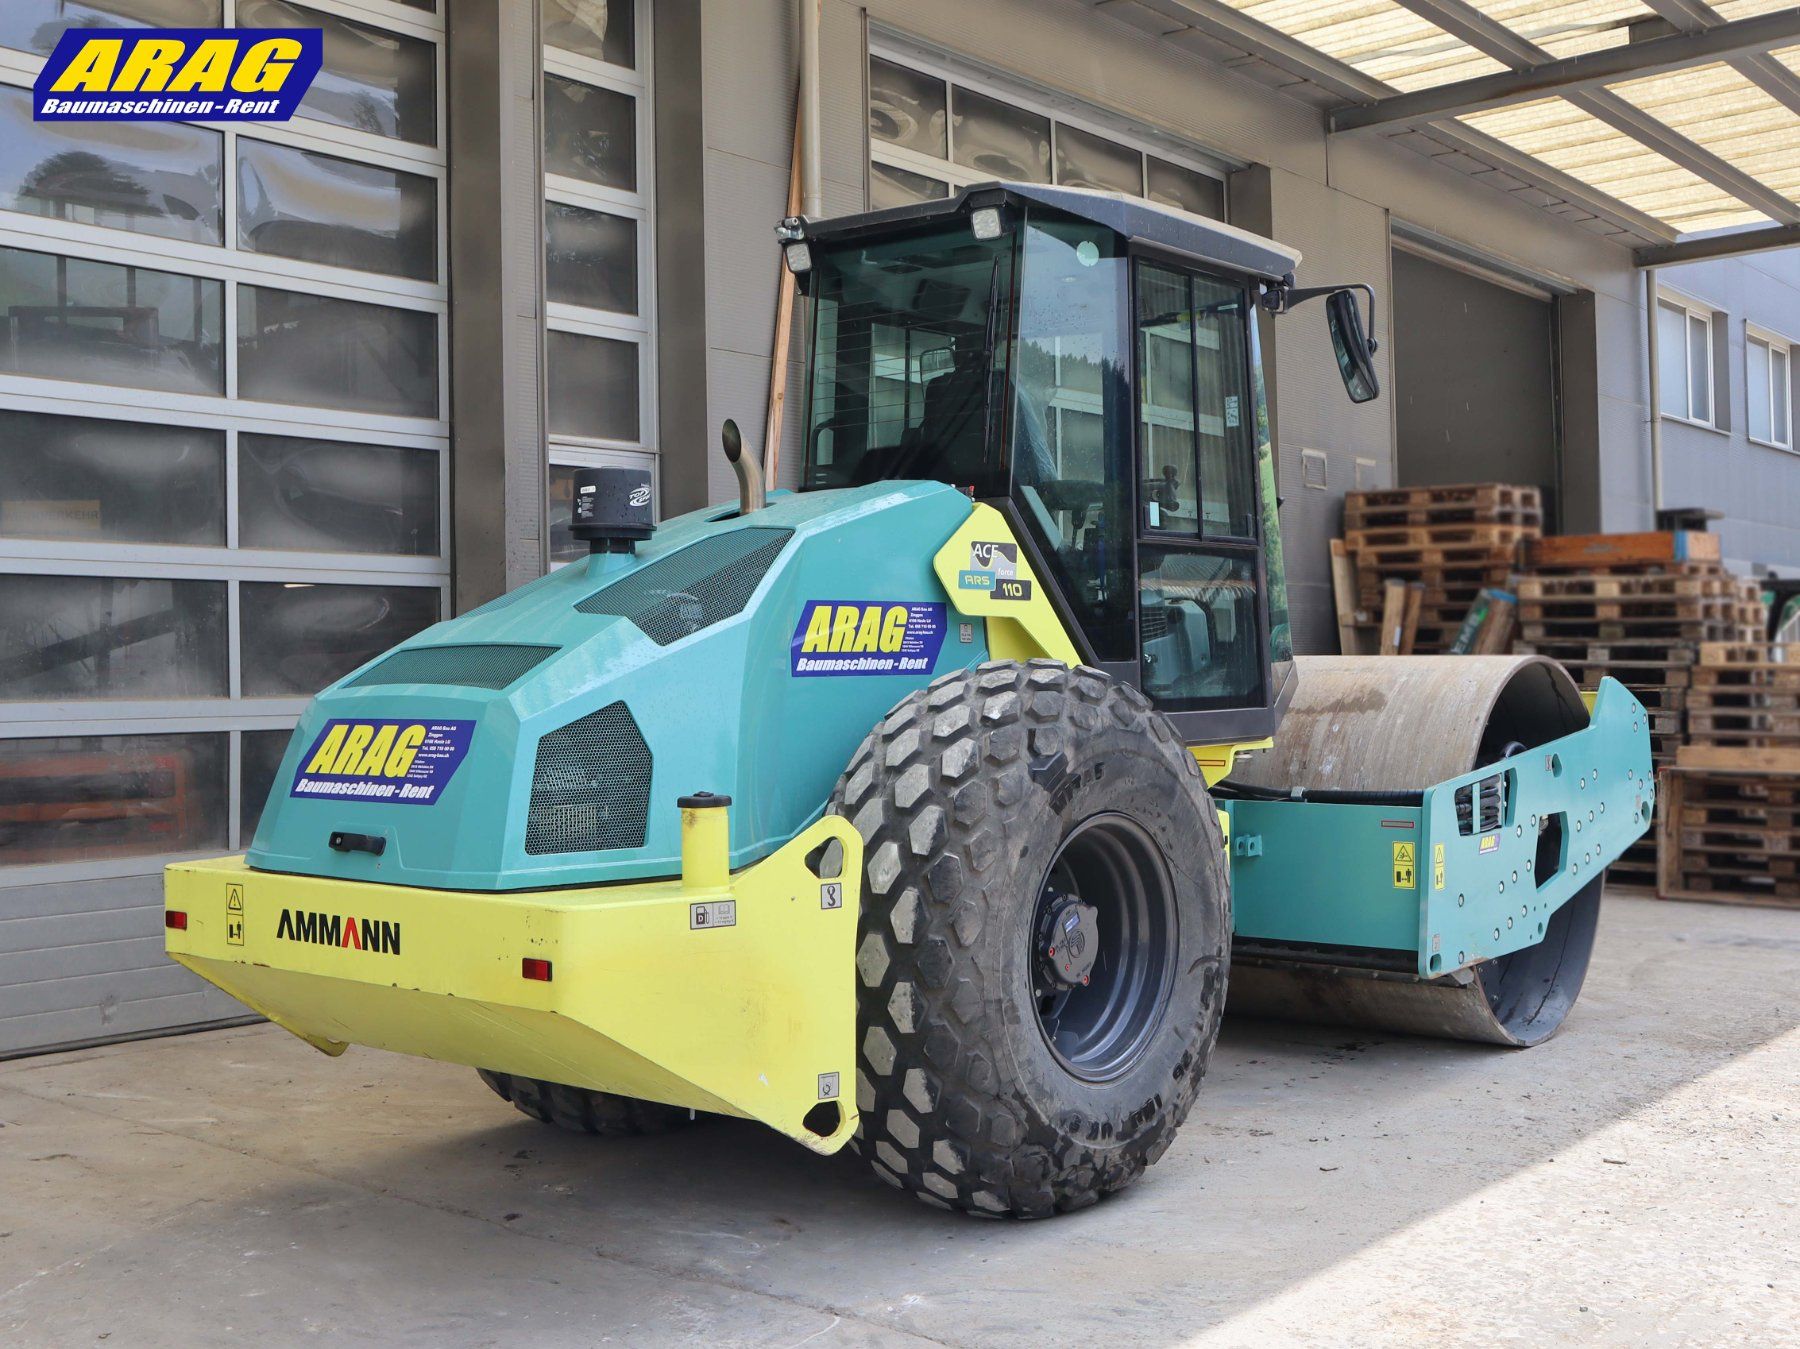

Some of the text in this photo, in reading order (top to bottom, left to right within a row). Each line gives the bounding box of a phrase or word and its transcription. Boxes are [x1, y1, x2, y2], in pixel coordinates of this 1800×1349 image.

[972, 544, 999, 558] ACE
[997, 568, 1014, 576] force
[964, 575, 990, 585] ARS
[1002, 582, 1023, 597] 110
[801, 605, 908, 653] ARAG
[305, 724, 427, 778] ARAG
[276, 908, 401, 956] AMMANN
